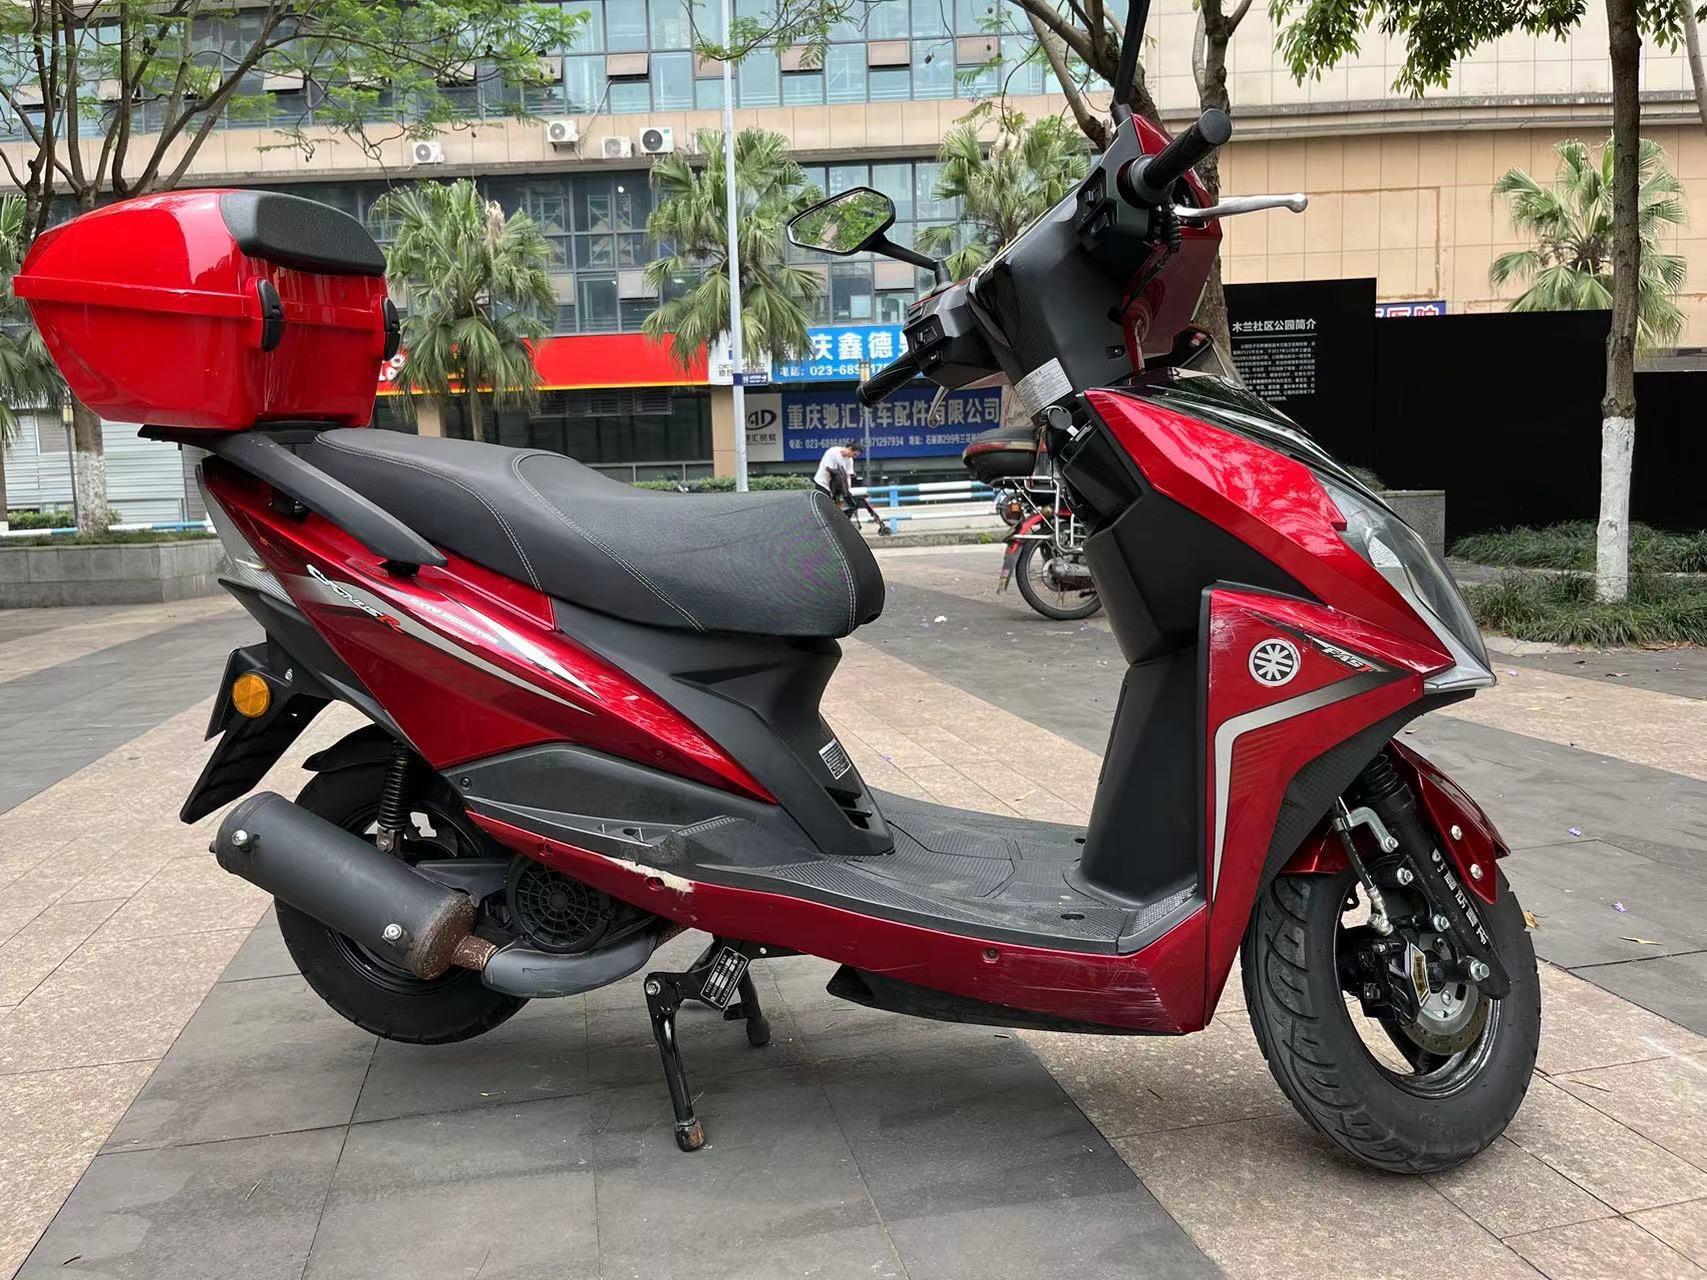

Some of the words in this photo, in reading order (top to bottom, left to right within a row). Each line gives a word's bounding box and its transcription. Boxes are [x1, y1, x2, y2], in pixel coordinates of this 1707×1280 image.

[1232, 318, 1317, 333] 木兰社区公园简介
[784, 330, 909, 361] 庆鑫德
